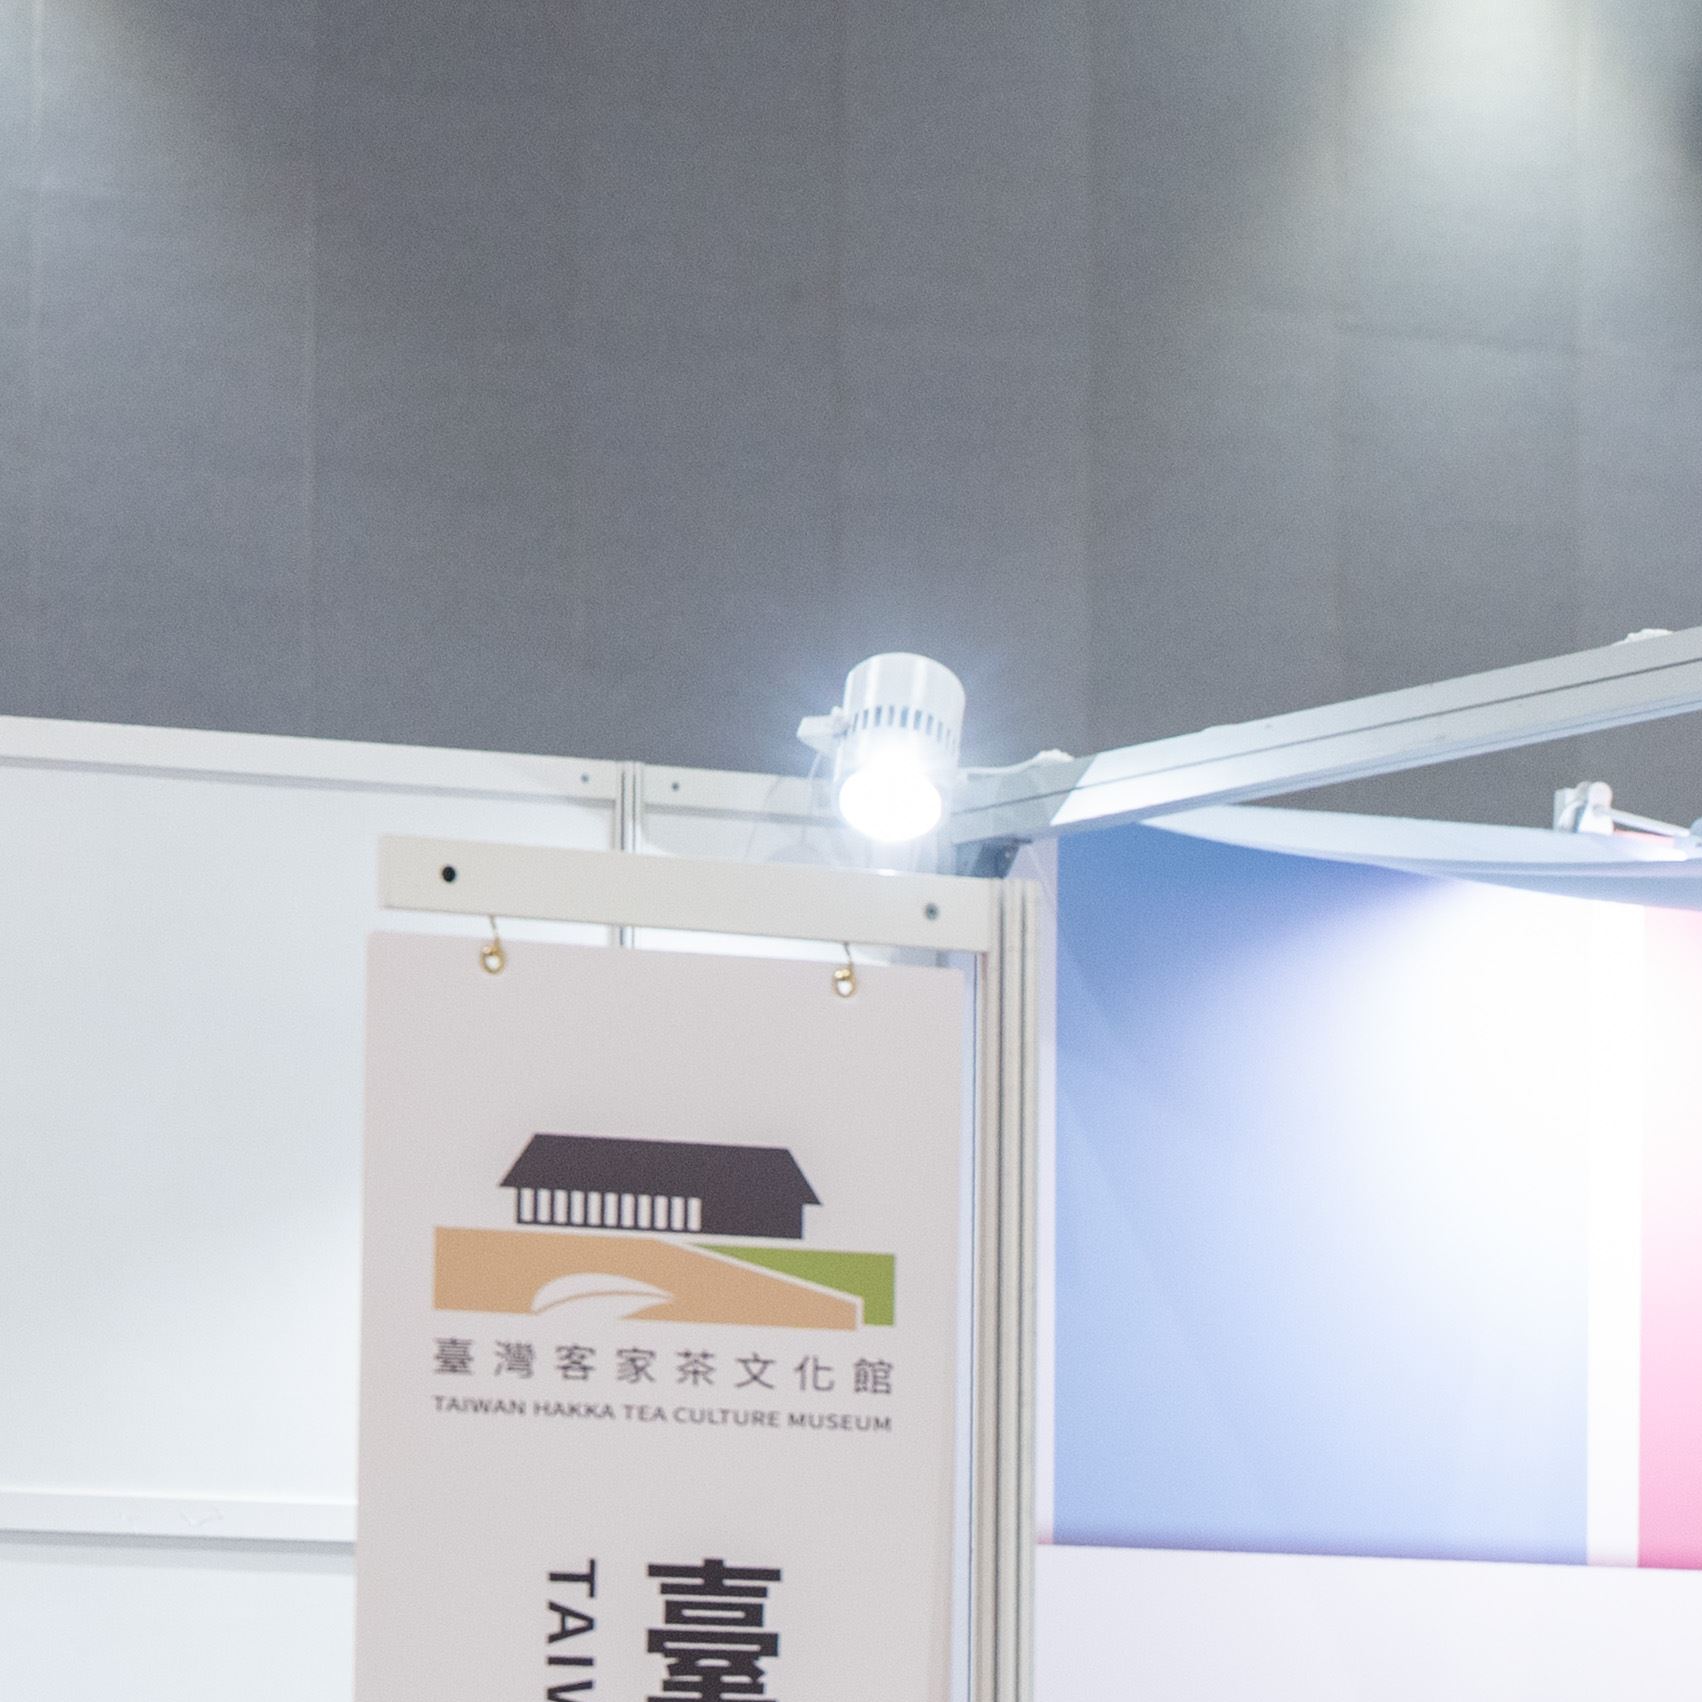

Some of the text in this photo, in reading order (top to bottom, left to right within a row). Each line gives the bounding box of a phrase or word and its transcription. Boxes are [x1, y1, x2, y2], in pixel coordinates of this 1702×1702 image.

[433, 1336, 896, 1396] 臺灣客家茶文化館
[433, 1395, 893, 1433] TAIWAN HAKKA TEA CULTURE MUSEUM
